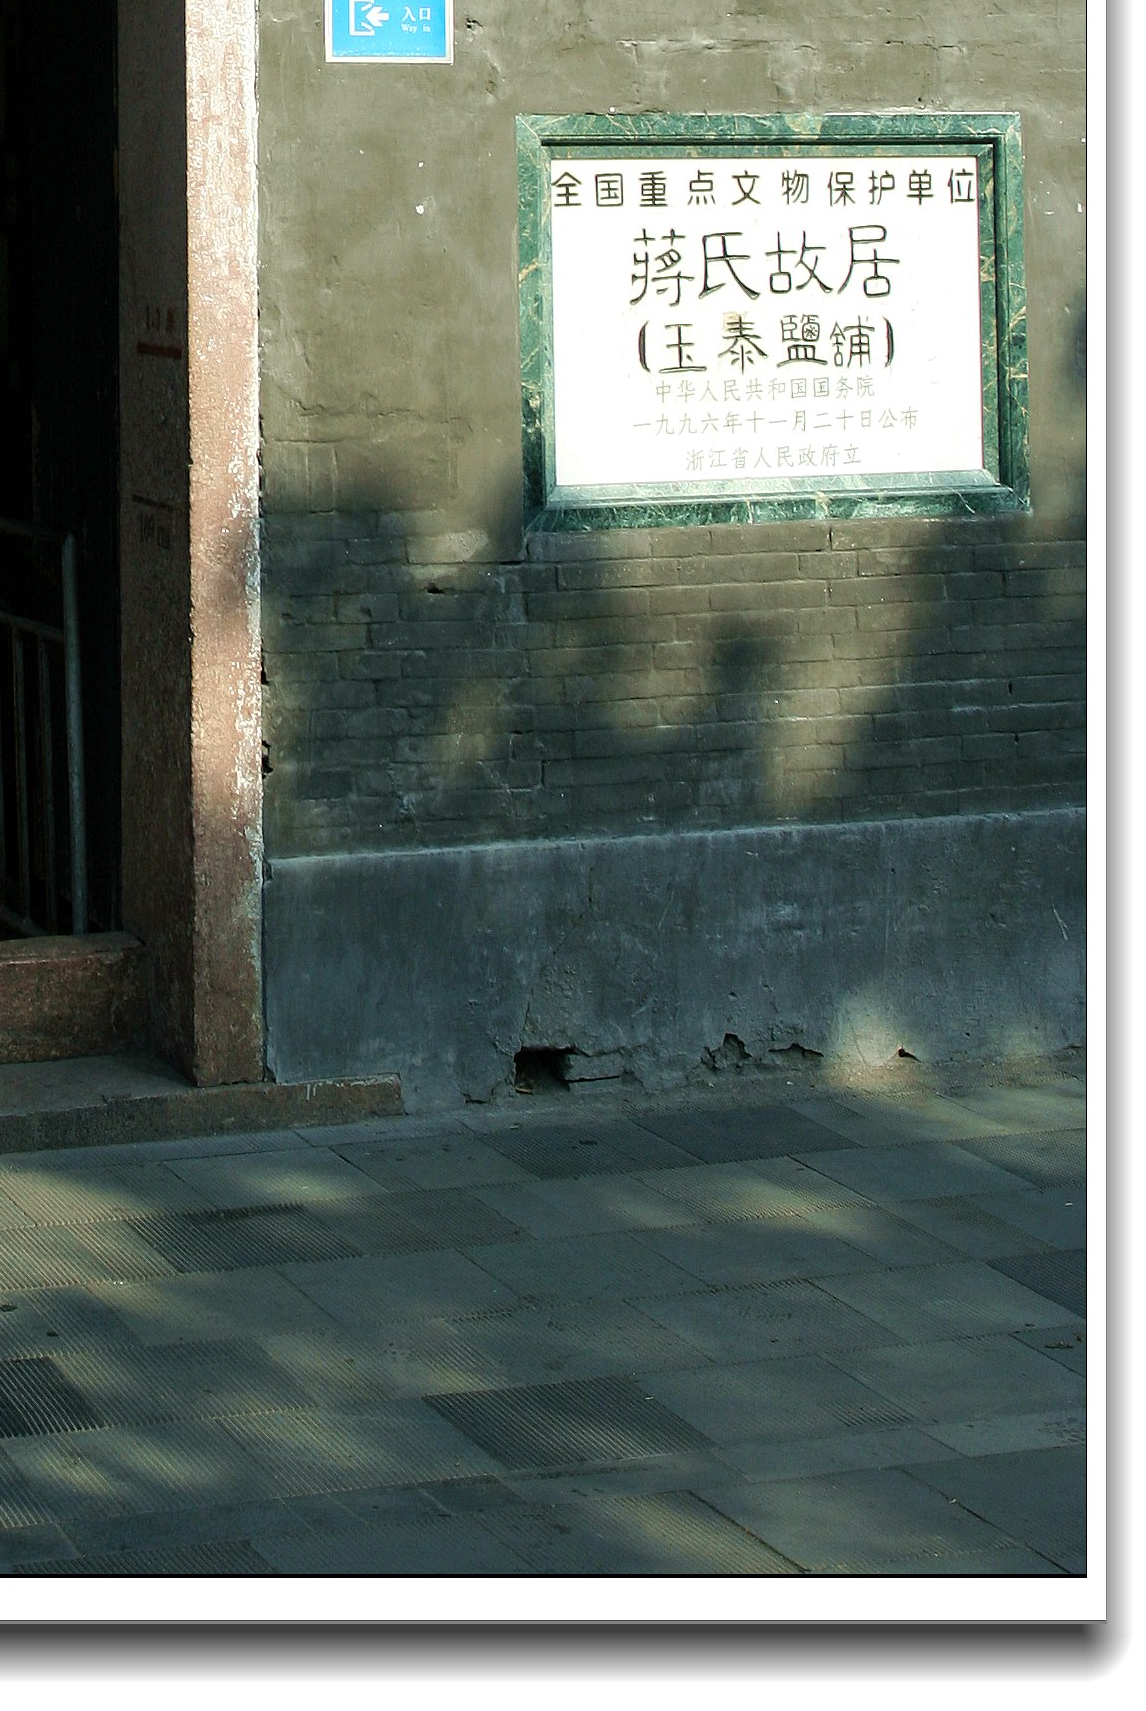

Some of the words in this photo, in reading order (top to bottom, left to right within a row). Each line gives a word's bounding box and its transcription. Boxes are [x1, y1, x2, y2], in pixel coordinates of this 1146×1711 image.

[401, 5, 431, 21] 入口
[551, 169, 977, 207] 全国重点文物保护单位
[655, 375, 875, 403] 中华人民共和国国务院
[633, 406, 919, 435] 一九九六年十一月二十日公布
[686, 443, 861, 471] 浙江省人民政府立
